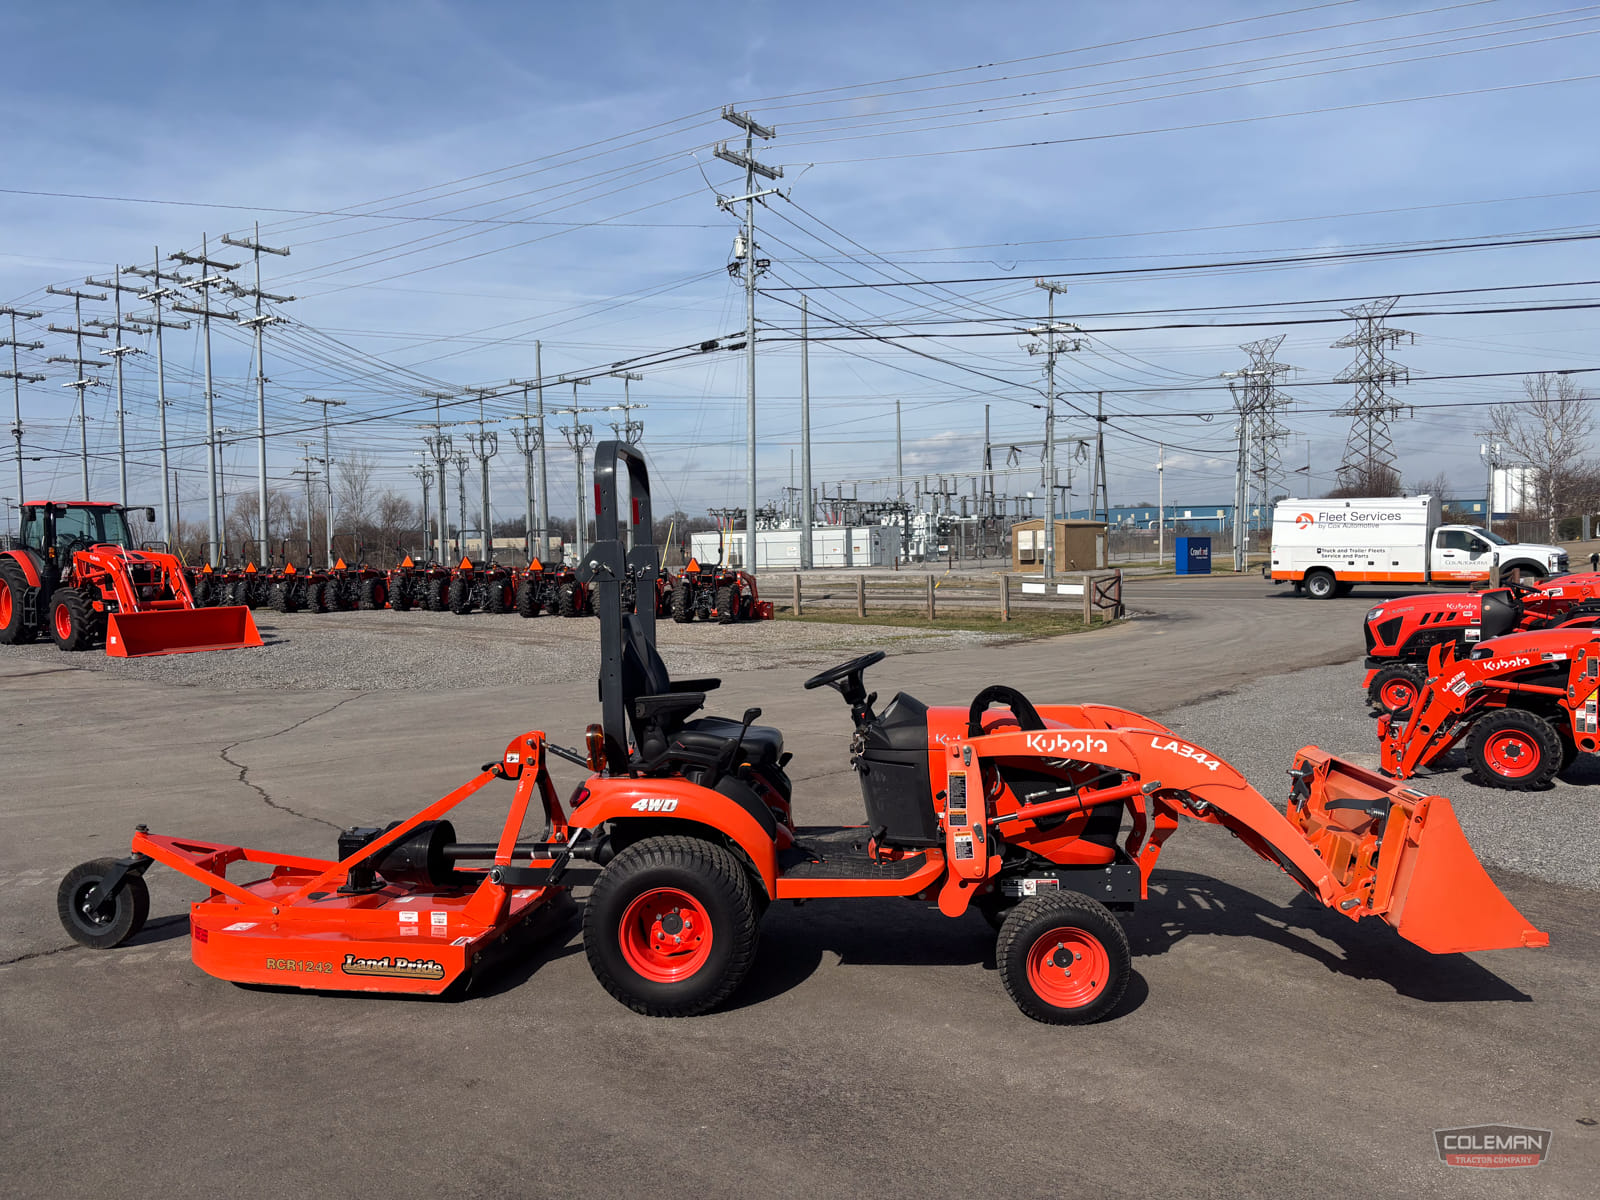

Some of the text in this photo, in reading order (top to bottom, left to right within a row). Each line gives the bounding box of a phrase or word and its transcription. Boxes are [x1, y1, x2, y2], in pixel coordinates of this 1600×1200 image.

[1319, 511, 1402, 521] Fleet Services
[1318, 522, 1326, 530] by
[1483, 656, 1530, 671] Kubota
[1026, 734, 1108, 753] Kubota
[1150, 737, 1221, 771] LA344
[631, 798, 679, 812] 4WD
[266, 958, 333, 974] RCR1242
[344, 954, 443, 974] Land Pride
